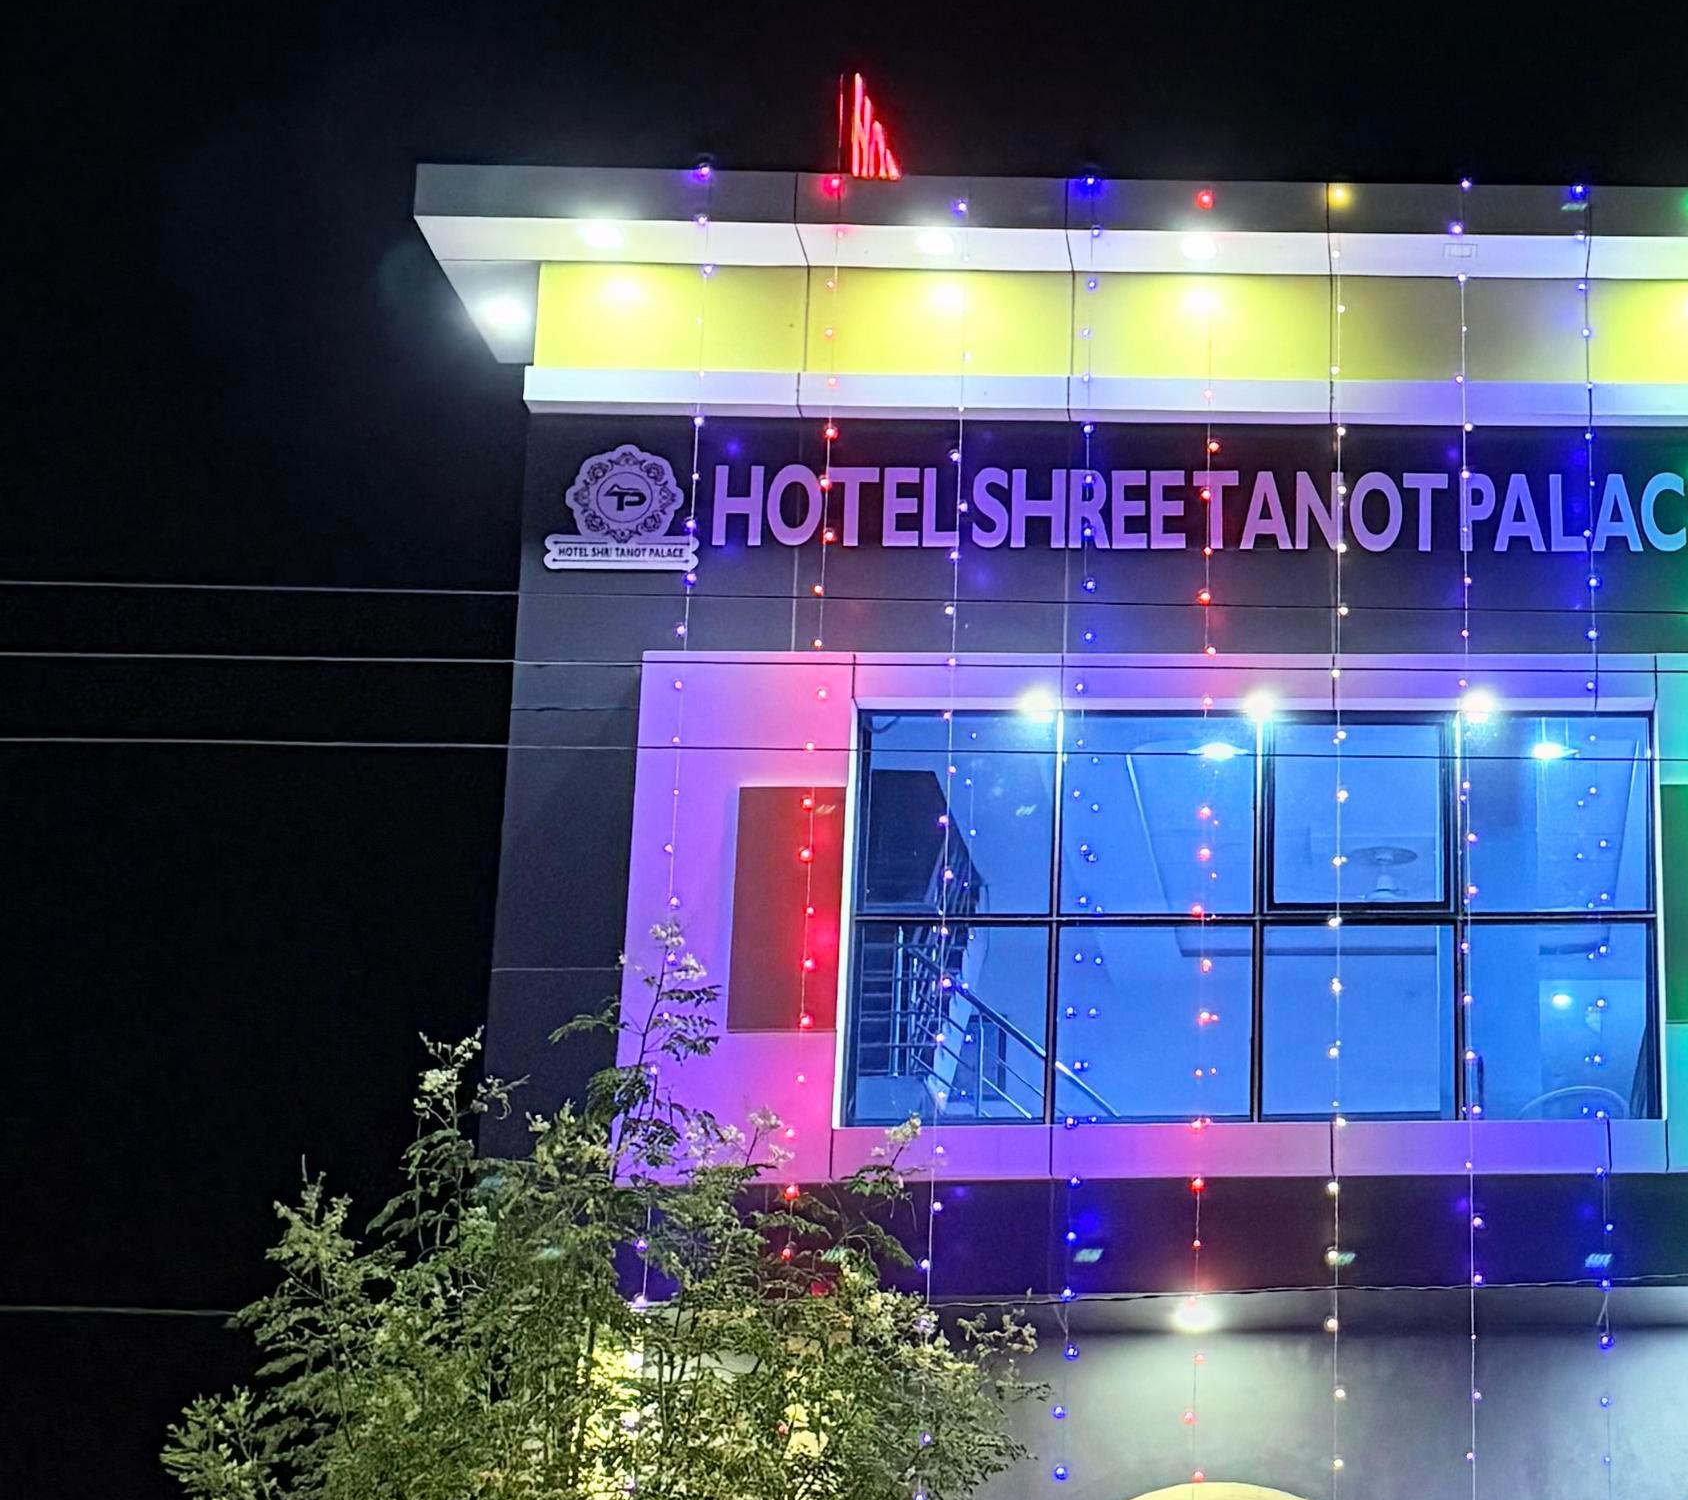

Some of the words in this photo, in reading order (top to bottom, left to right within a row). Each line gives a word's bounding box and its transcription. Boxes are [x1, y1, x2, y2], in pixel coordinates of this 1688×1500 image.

[710, 464, 959, 548] HOTEL
[971, 466, 1187, 550] SHREE
[1192, 469, 1448, 553] TANOT
[558, 547, 589, 558] HOTEL
[615, 547, 646, 558] TANOT
[649, 548, 685, 559] PALACE
